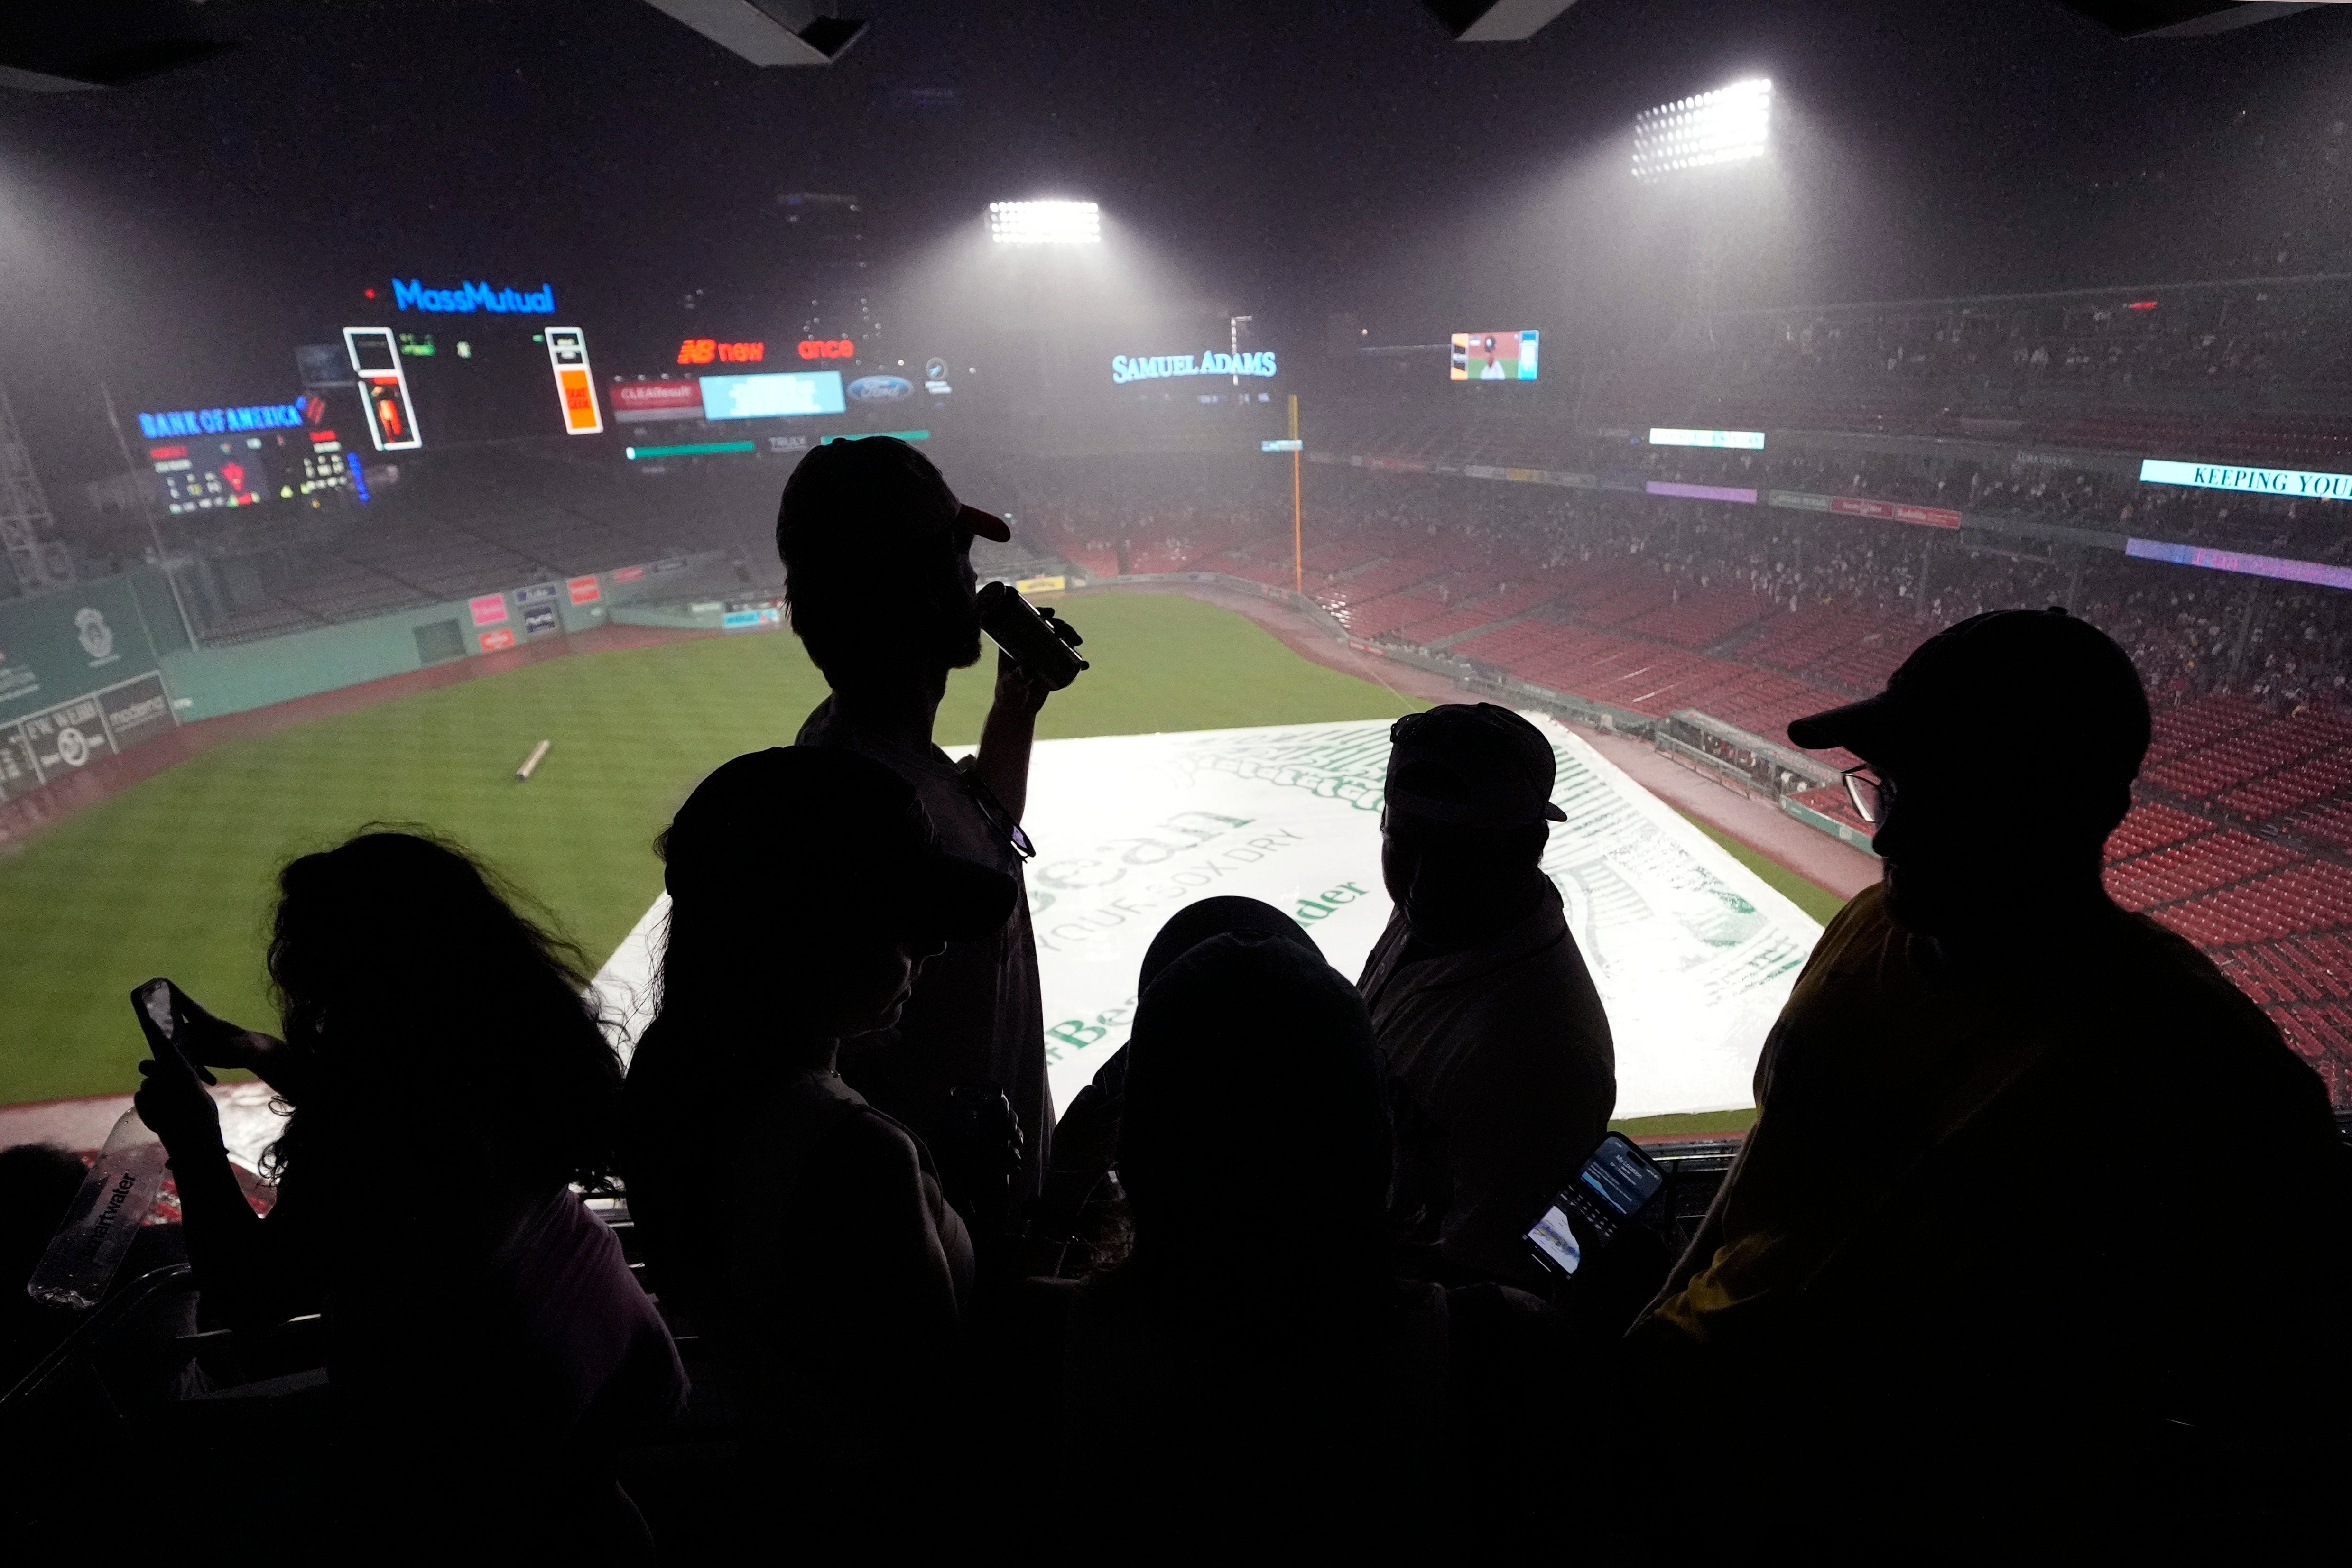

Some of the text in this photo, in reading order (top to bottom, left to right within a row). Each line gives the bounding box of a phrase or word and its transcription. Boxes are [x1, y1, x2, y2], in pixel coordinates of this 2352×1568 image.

[392, 278, 555, 313] MassMutual
[717, 342, 764, 362] new
[1112, 350, 1277, 384] SAMUEL ADAMS
[139, 404, 303, 439] BANK OF AMERICA
[2194, 467, 2352, 497] KEEPING YOU
[1028, 810, 1257, 915] ean
[1145, 859, 1239, 899] SOX
[1222, 827, 1304, 863] DRY
